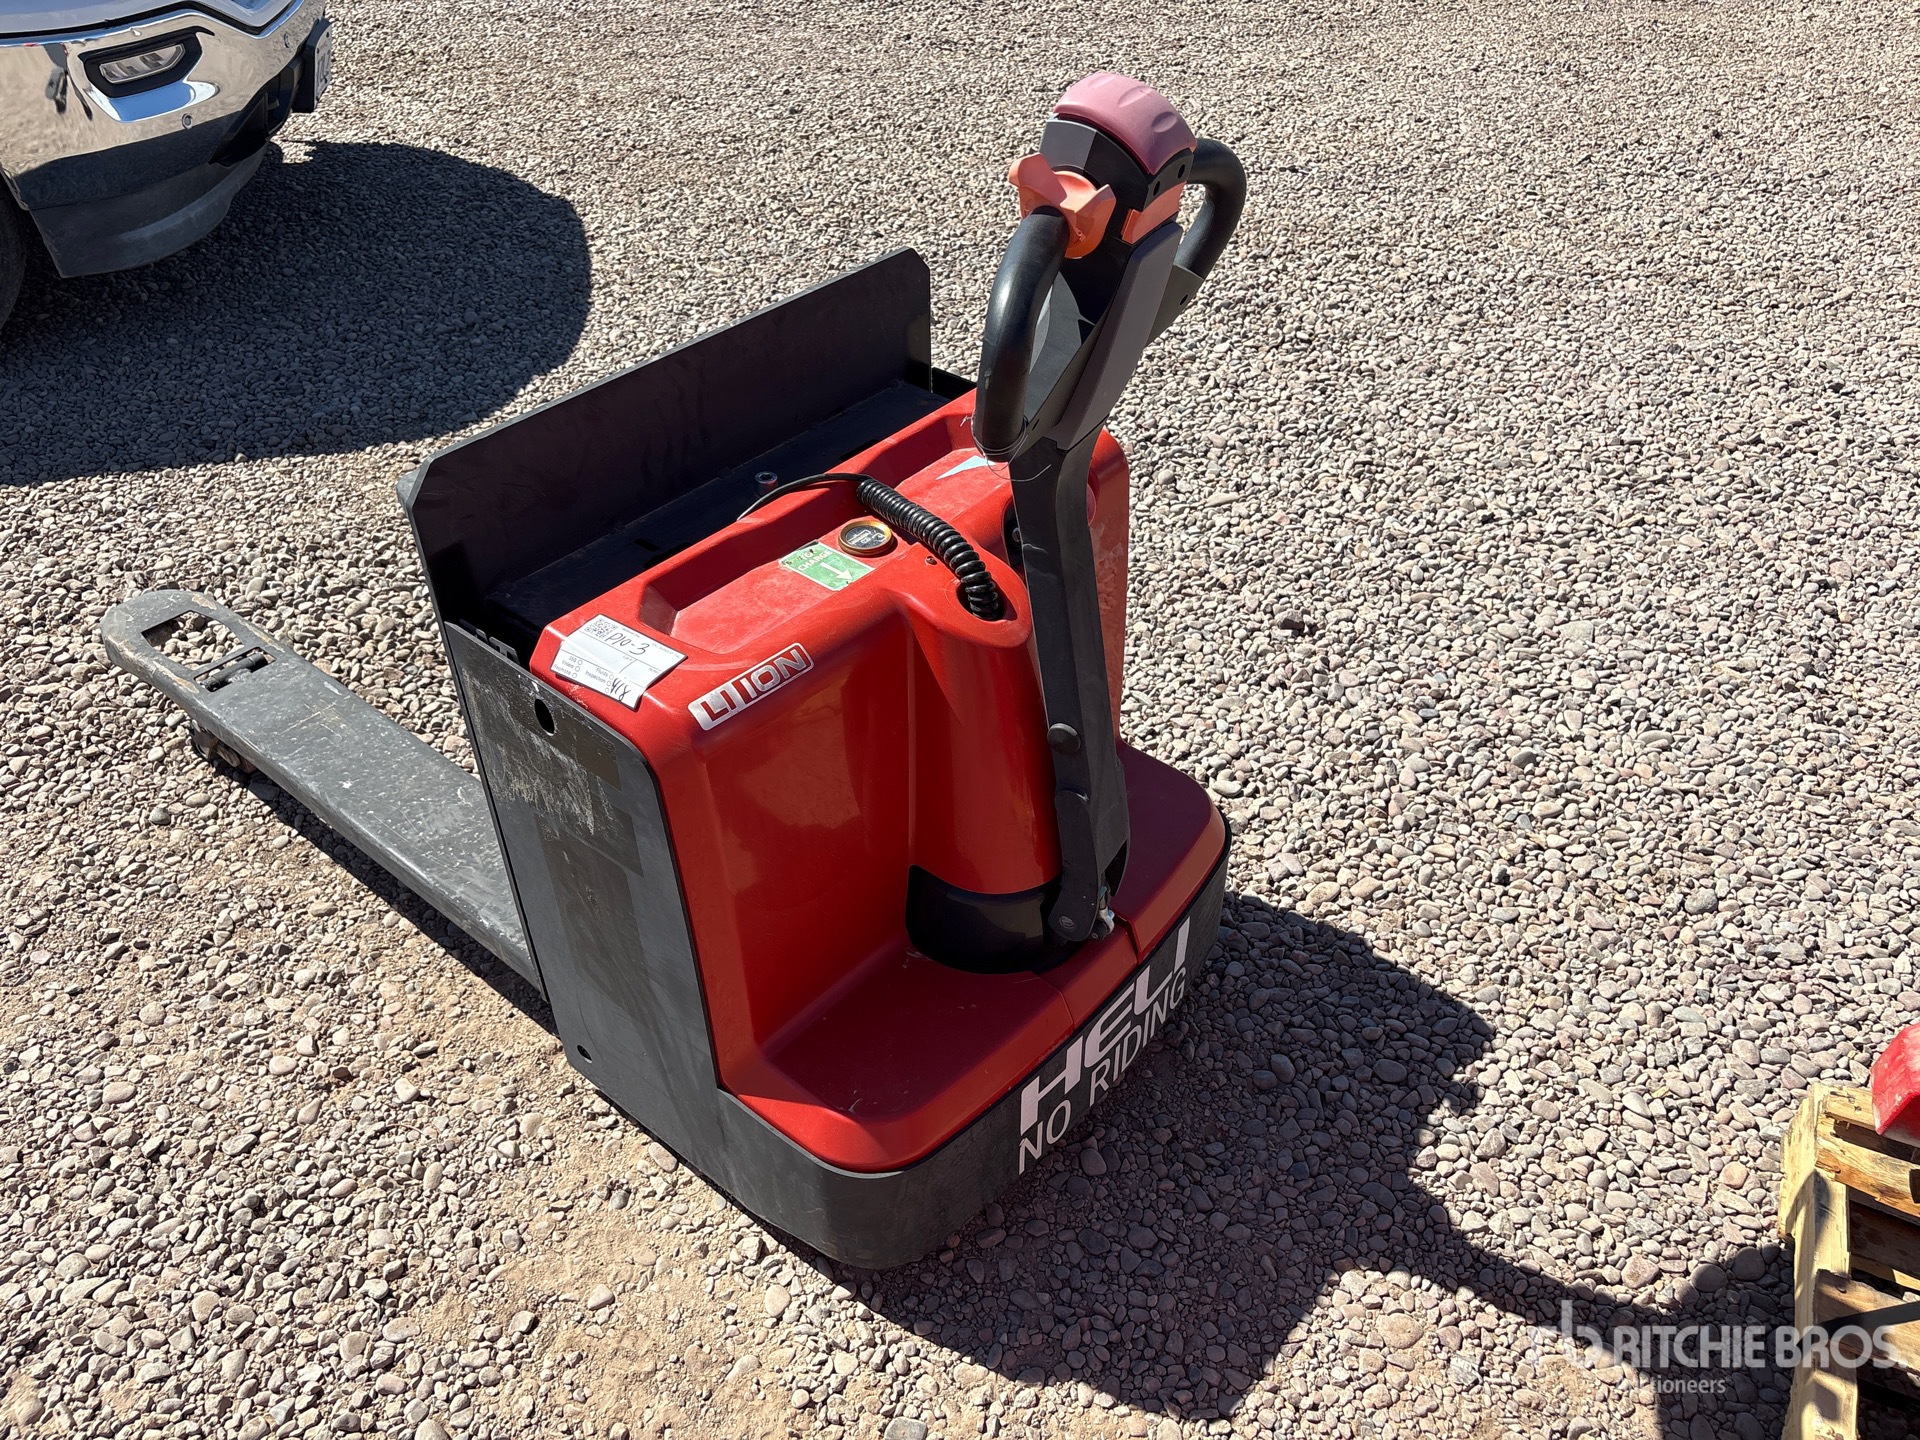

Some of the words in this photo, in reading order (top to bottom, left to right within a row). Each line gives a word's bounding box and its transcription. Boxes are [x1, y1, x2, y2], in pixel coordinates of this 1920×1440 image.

[797, 549, 833, 571] CHARGE
[585, 670, 606, 684] Inspection
[740, 649, 806, 699] ION
[1020, 916, 1190, 1137] HELI
[1019, 1099, 1071, 1175] NO
[1089, 966, 1187, 1107] RIDING
